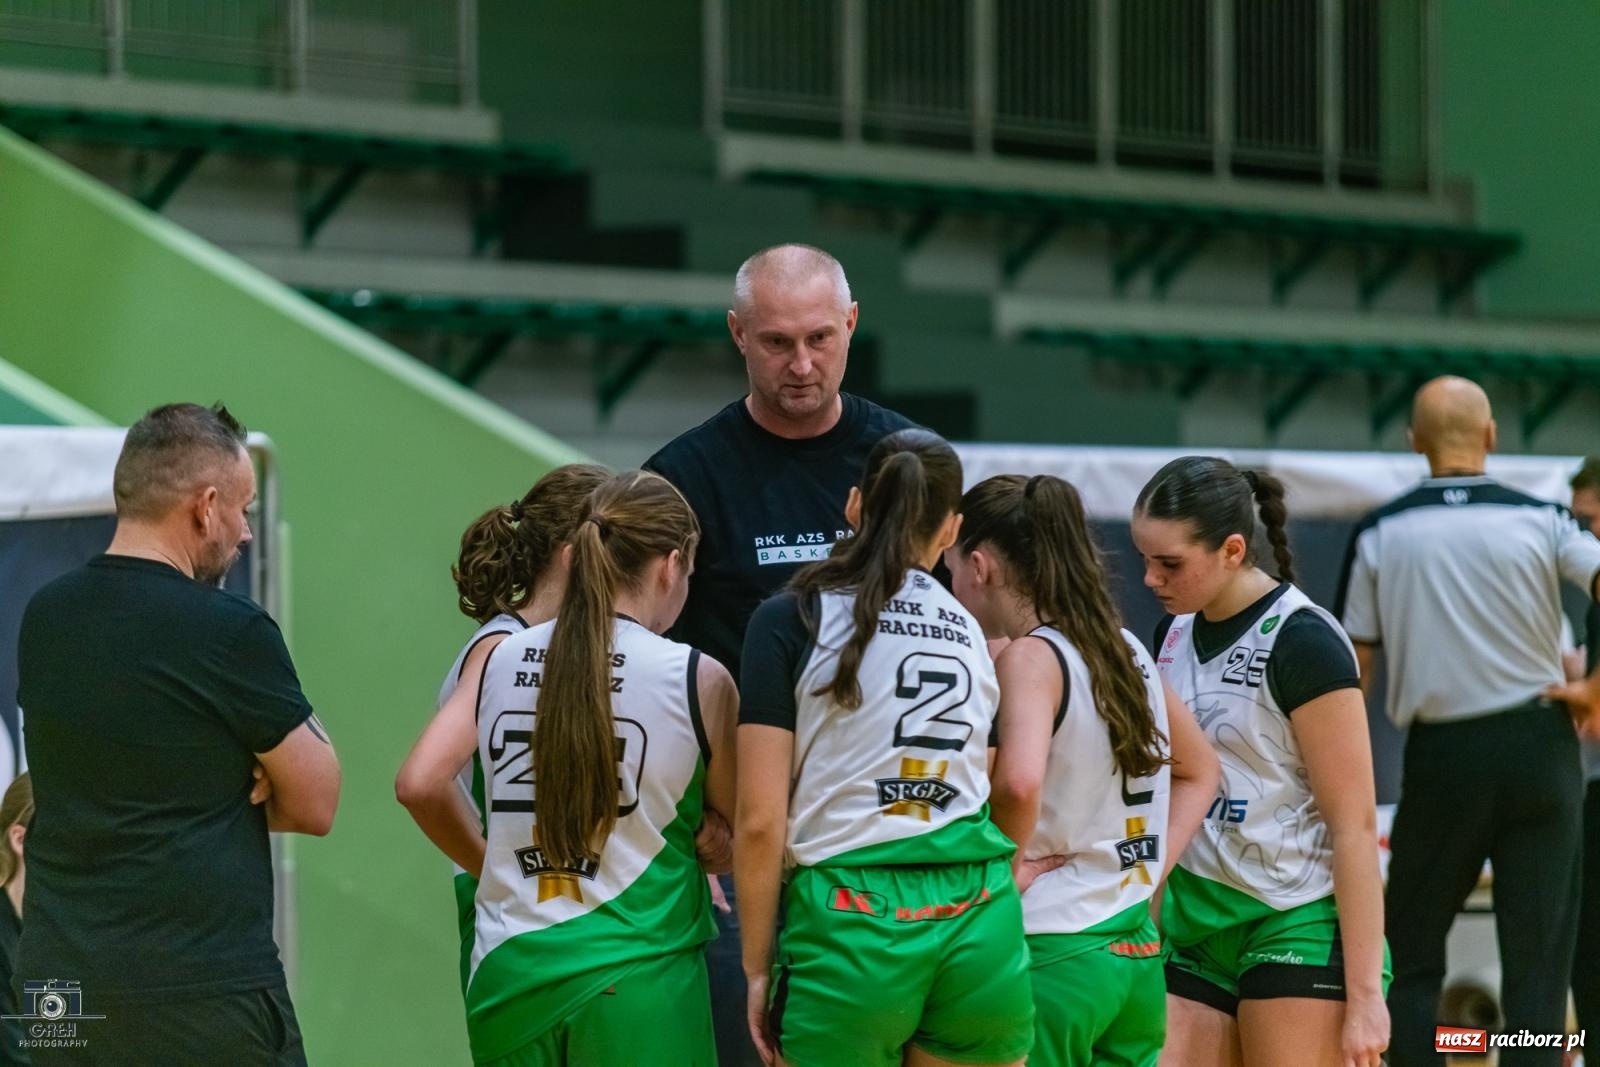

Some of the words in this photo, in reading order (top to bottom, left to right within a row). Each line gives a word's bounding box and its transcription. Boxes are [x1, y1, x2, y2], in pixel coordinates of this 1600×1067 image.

[755, 534, 786, 547] RKK
[796, 532, 825, 544] AZS
[881, 599, 924, 616] RKK
[893, 652, 974, 752] 2
